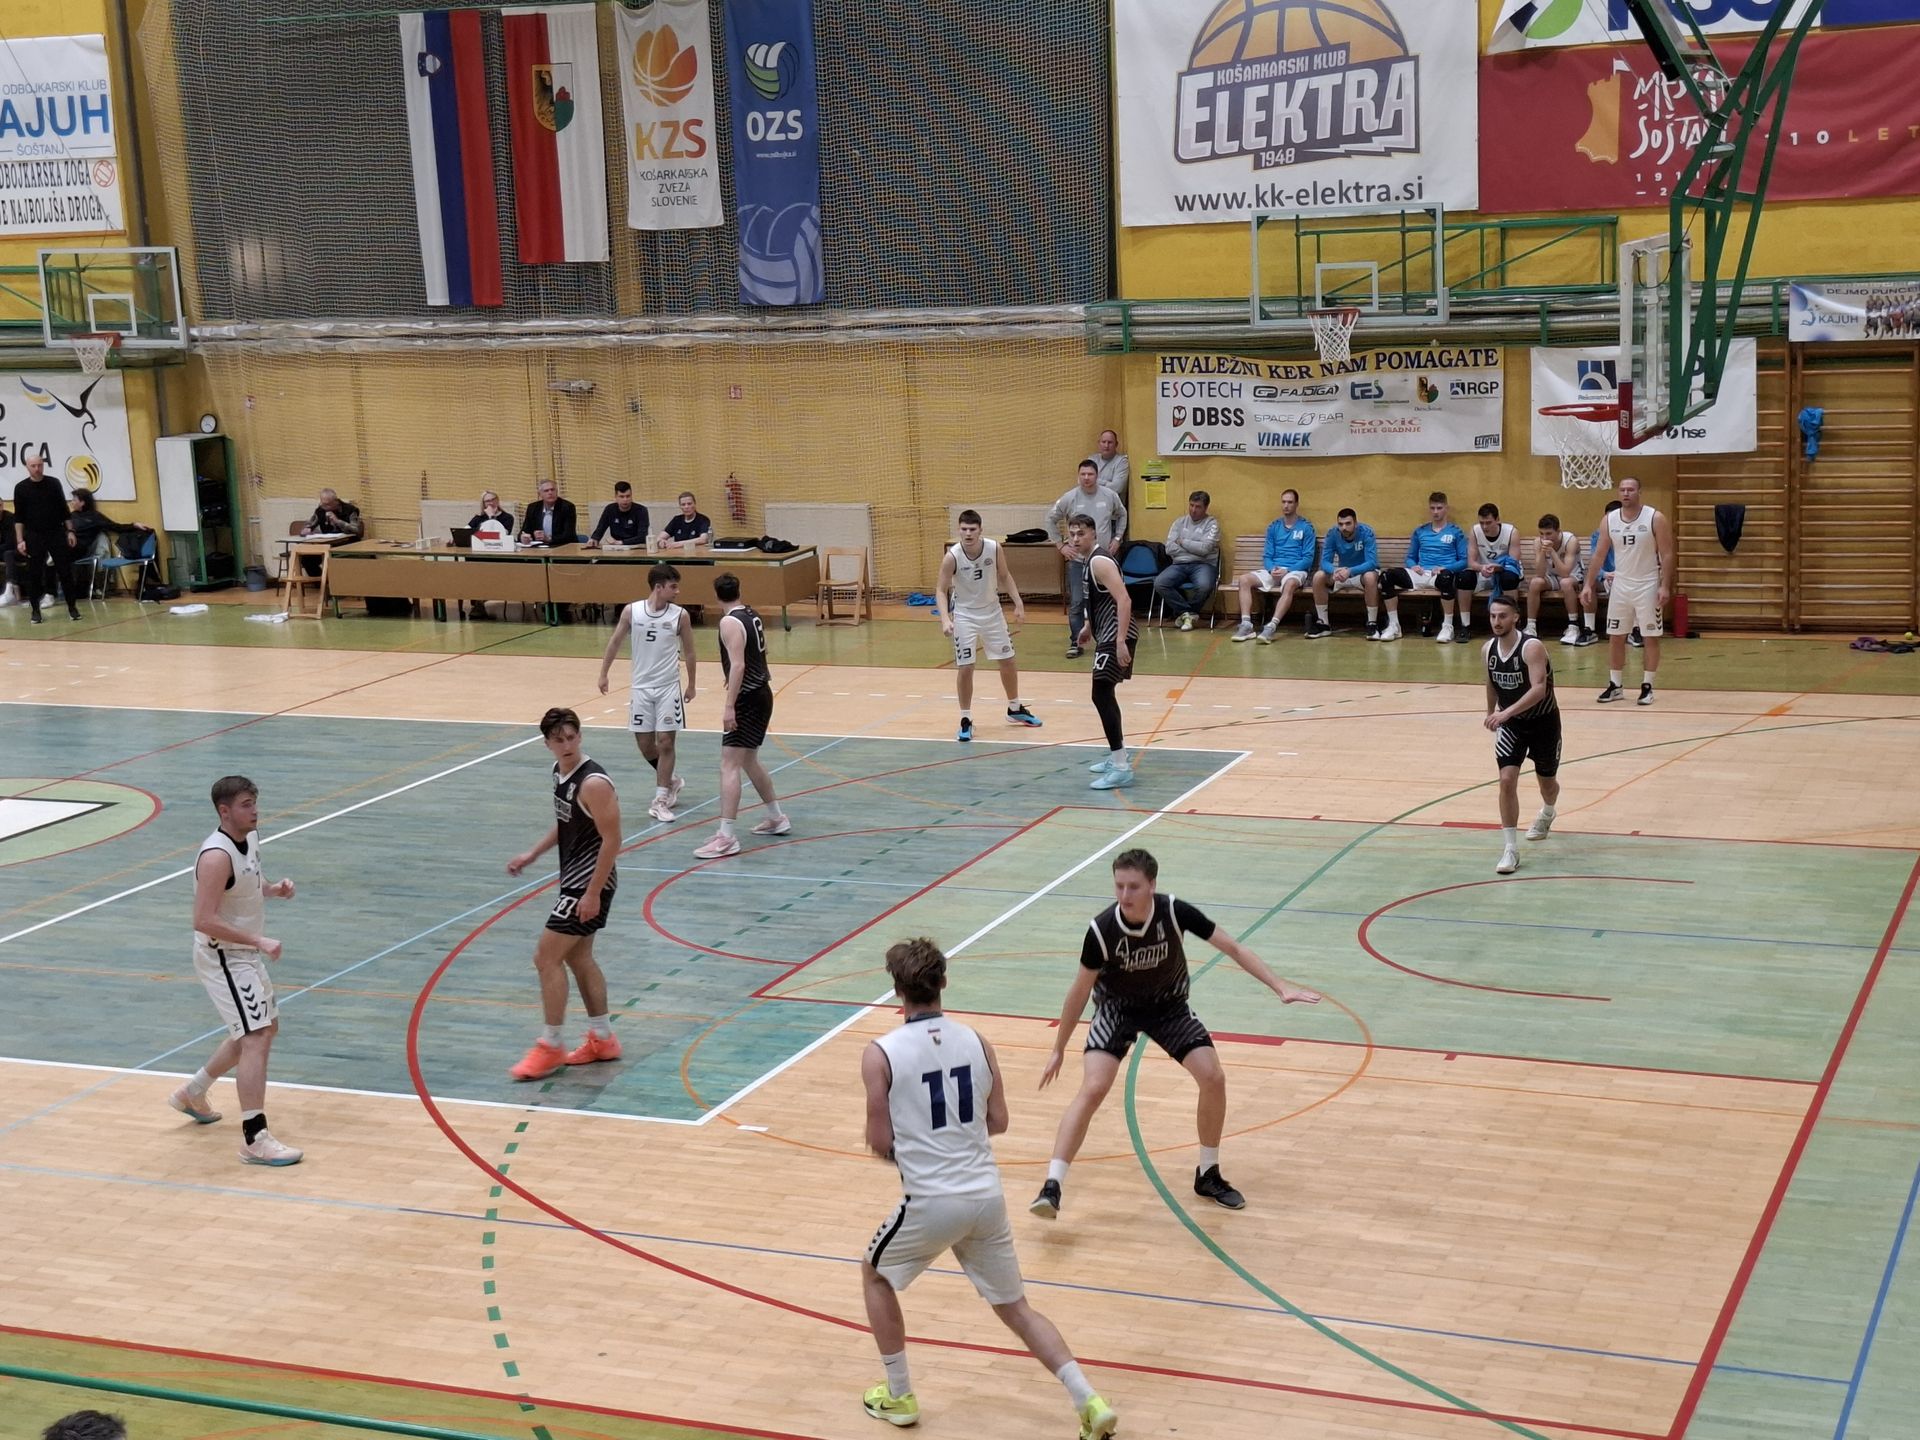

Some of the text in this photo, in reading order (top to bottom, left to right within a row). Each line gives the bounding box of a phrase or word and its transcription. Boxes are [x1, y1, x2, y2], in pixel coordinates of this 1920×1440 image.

[1217, 49, 1347, 86] KOŠARKARSKI KLUB
[2, 79, 107, 95] ODBOJKARSKI KLUB
[1177, 60, 1417, 159] ELEKTRA
[746, 109, 804, 142] OZS
[635, 118, 707, 161] KZS
[16, 143, 64, 157] ŠOŠTANJ
[1259, 149, 1296, 167] 1948
[658, 182, 691, 194] ZVEZA
[1174, 175, 1424, 212] www.kk-elektra.si
[68, 195, 103, 222] DROGA
[1819, 315, 1858, 324] KAJUH
[1160, 348, 1499, 380] HVALEŽNI KER NAM POMAGATE
[1161, 381, 1242, 399] ESOTECH
[1467, 380, 1499, 395] RGP
[1192, 407, 1245, 427] DBSS
[1254, 413, 1344, 422] SPACE BAR
[1258, 432, 1311, 447] VIRNEK
[1681, 426, 1706, 439] hse
[1622, 534, 1636, 545] 13
[973, 569, 983, 581] 3
[645, 630, 656, 642] 5
[962, 647, 972, 658] 3
[633, 714, 644, 726] 5
[921, 1064, 974, 1131] 11
